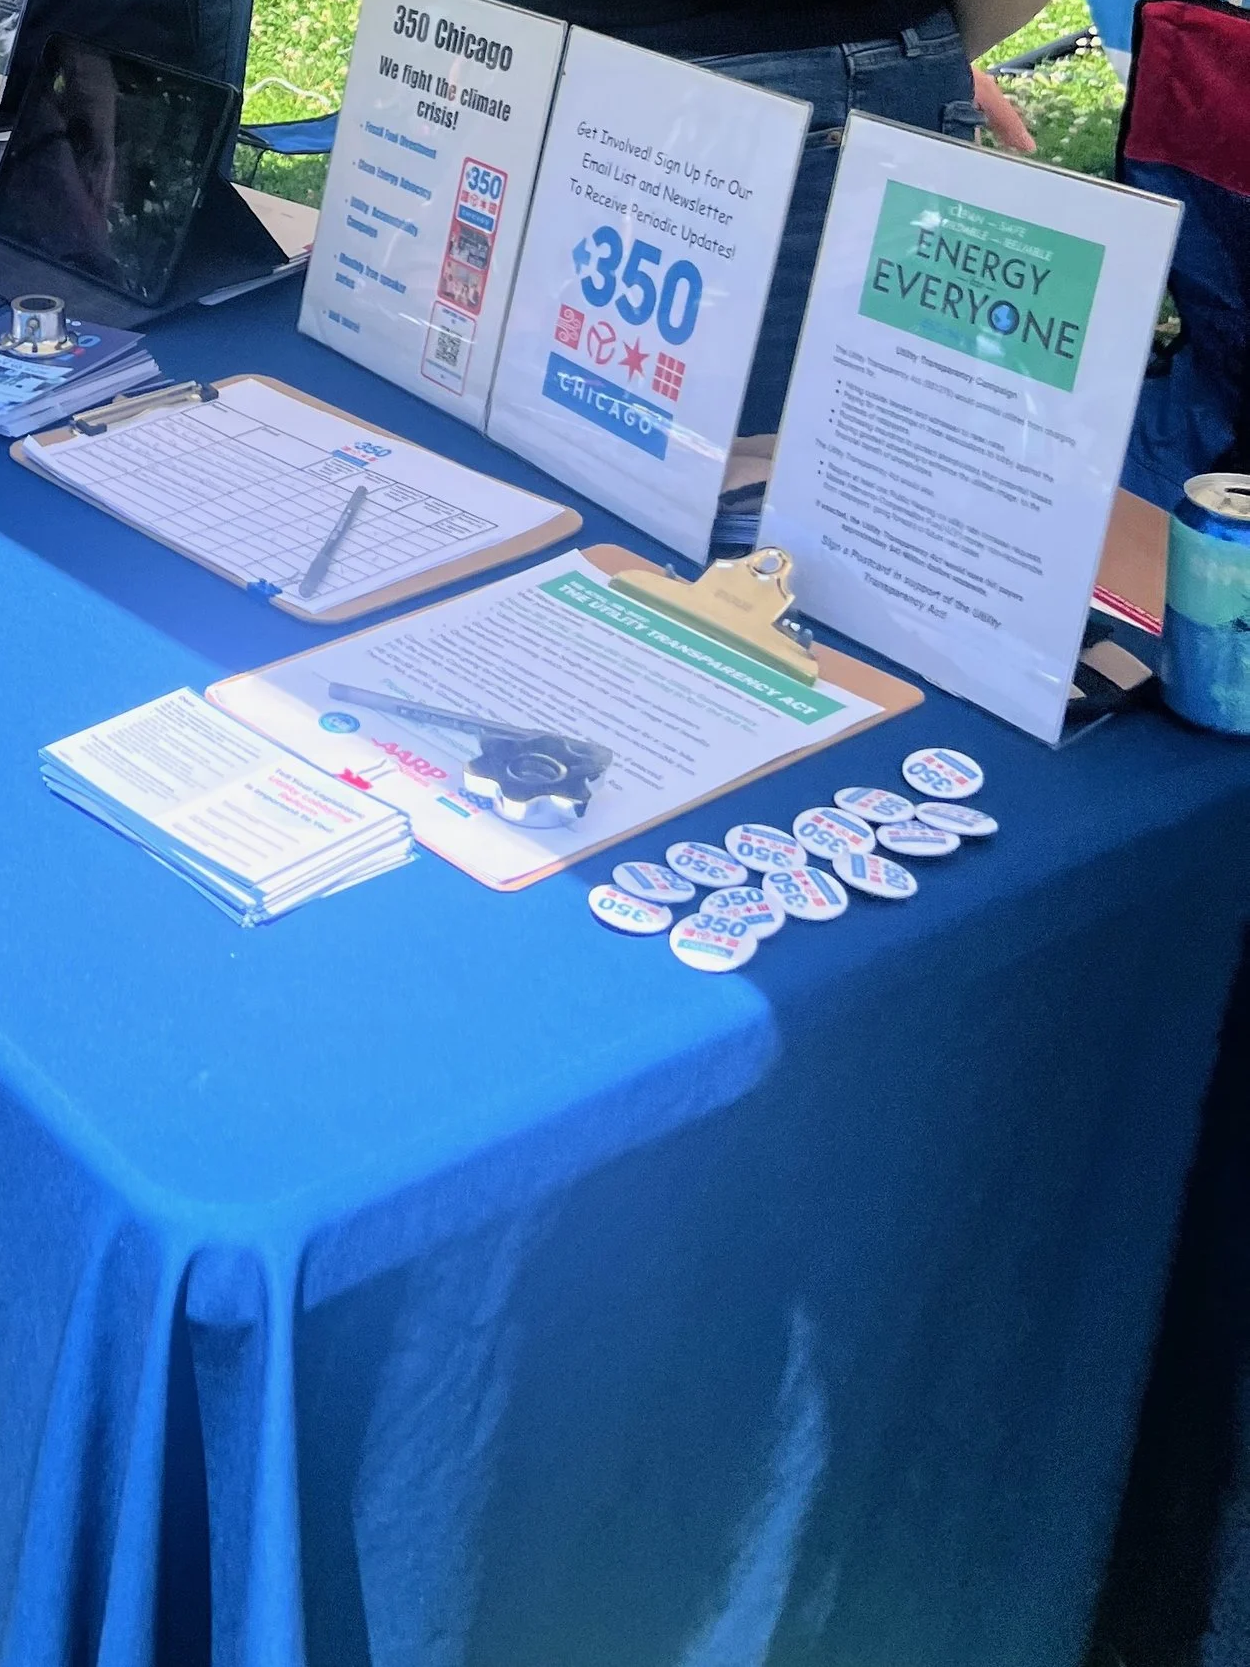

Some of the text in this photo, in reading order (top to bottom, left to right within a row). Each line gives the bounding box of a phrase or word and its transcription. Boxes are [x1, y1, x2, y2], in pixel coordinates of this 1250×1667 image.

[393, 4, 513, 72] 350 Chicago
[379, 55, 511, 122] We fight the climate
[417, 100, 459, 130] crisis!
[577, 121, 753, 200] Get Involved! Sign Up for Our
[467, 166, 502, 200] 350
[582, 153, 733, 226] Email List and Newsletter
[570, 178, 736, 260] To Receive Periodic Updates!
[916, 228, 1052, 295] ENERGY
[580, 225, 703, 346] 350
[872, 257, 1079, 360] EVERYONE
[556, 373, 654, 434] CHICAGO
[589, 598, 650, 631] UTILITY
[647, 628, 782, 698] TRANSPARENCY
[777, 692, 819, 715] ACT
[382, 742, 448, 779] AARP
[907, 762, 952, 792] 350
[737, 842, 788, 867] 350
[800, 822, 847, 853] 350
[675, 853, 723, 880] 350
[716, 886, 764, 909] 350
[769, 871, 809, 908] 350
[598, 896, 649, 924] 350
[694, 912, 748, 938] 350
